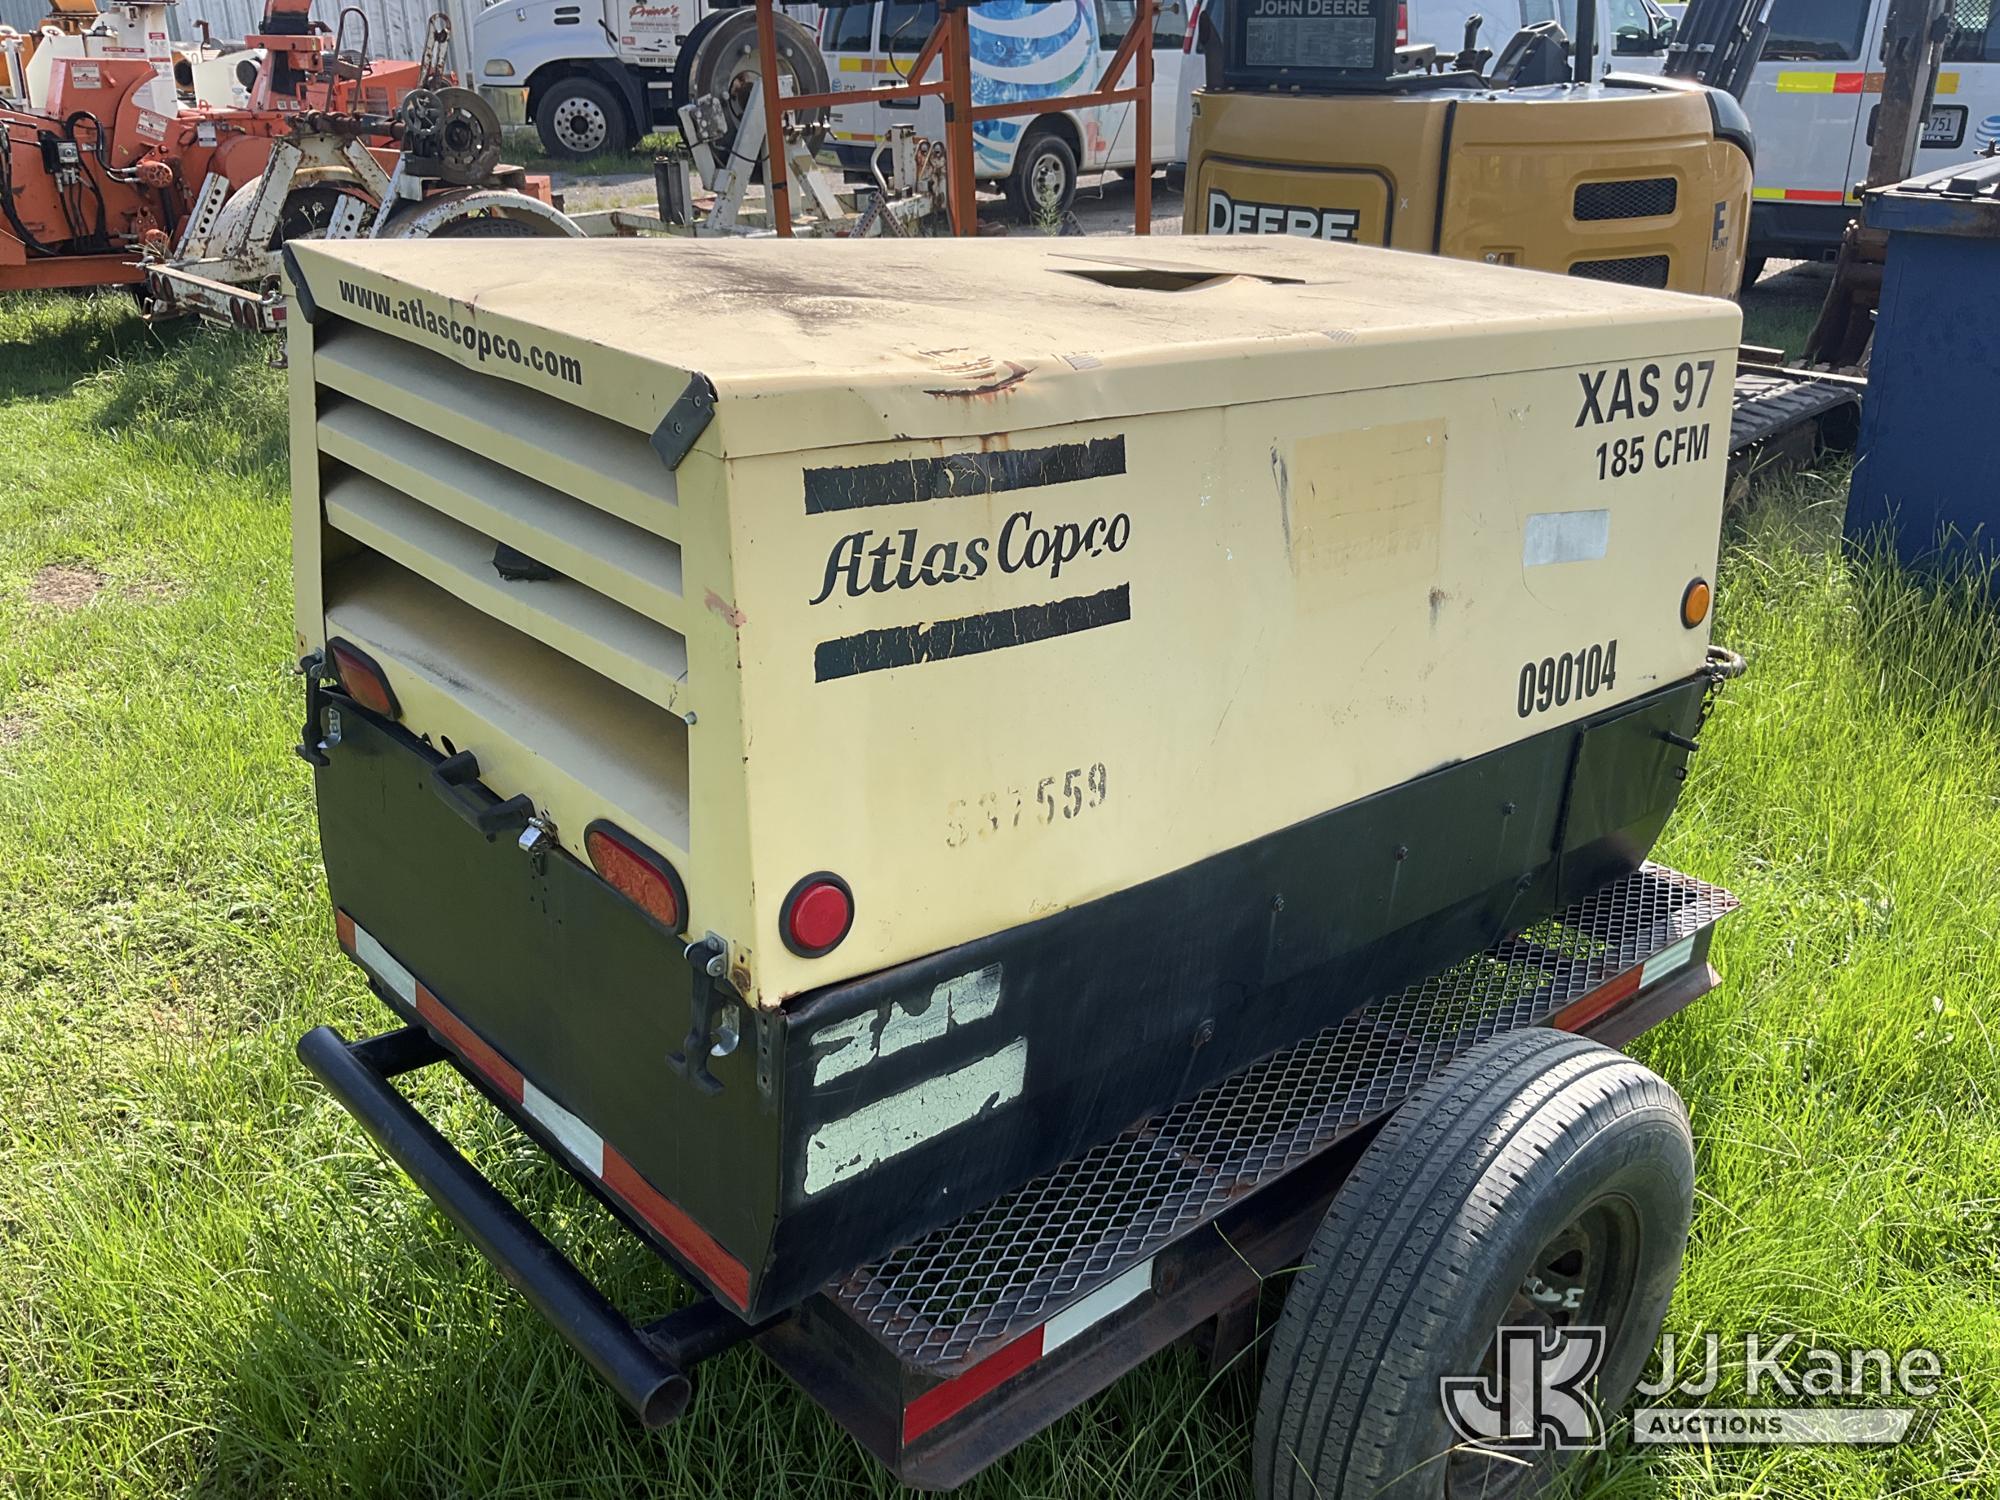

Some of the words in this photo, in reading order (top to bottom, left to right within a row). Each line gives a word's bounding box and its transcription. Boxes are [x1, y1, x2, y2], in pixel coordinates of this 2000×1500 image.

[1254, 0, 1302, 16] JOHN
[1307, 0, 1370, 16] DEERE
[338, 280, 583, 386] www.atlascopco.com
[1574, 363, 1660, 428] XAS
[1672, 360, 1715, 413] 97
[1595, 435, 1645, 480] 185
[1654, 423, 1710, 469] CFM
[809, 528, 989, 605] Atlas
[997, 510, 1131, 579] Copco
[1517, 639, 1618, 718] 090104
